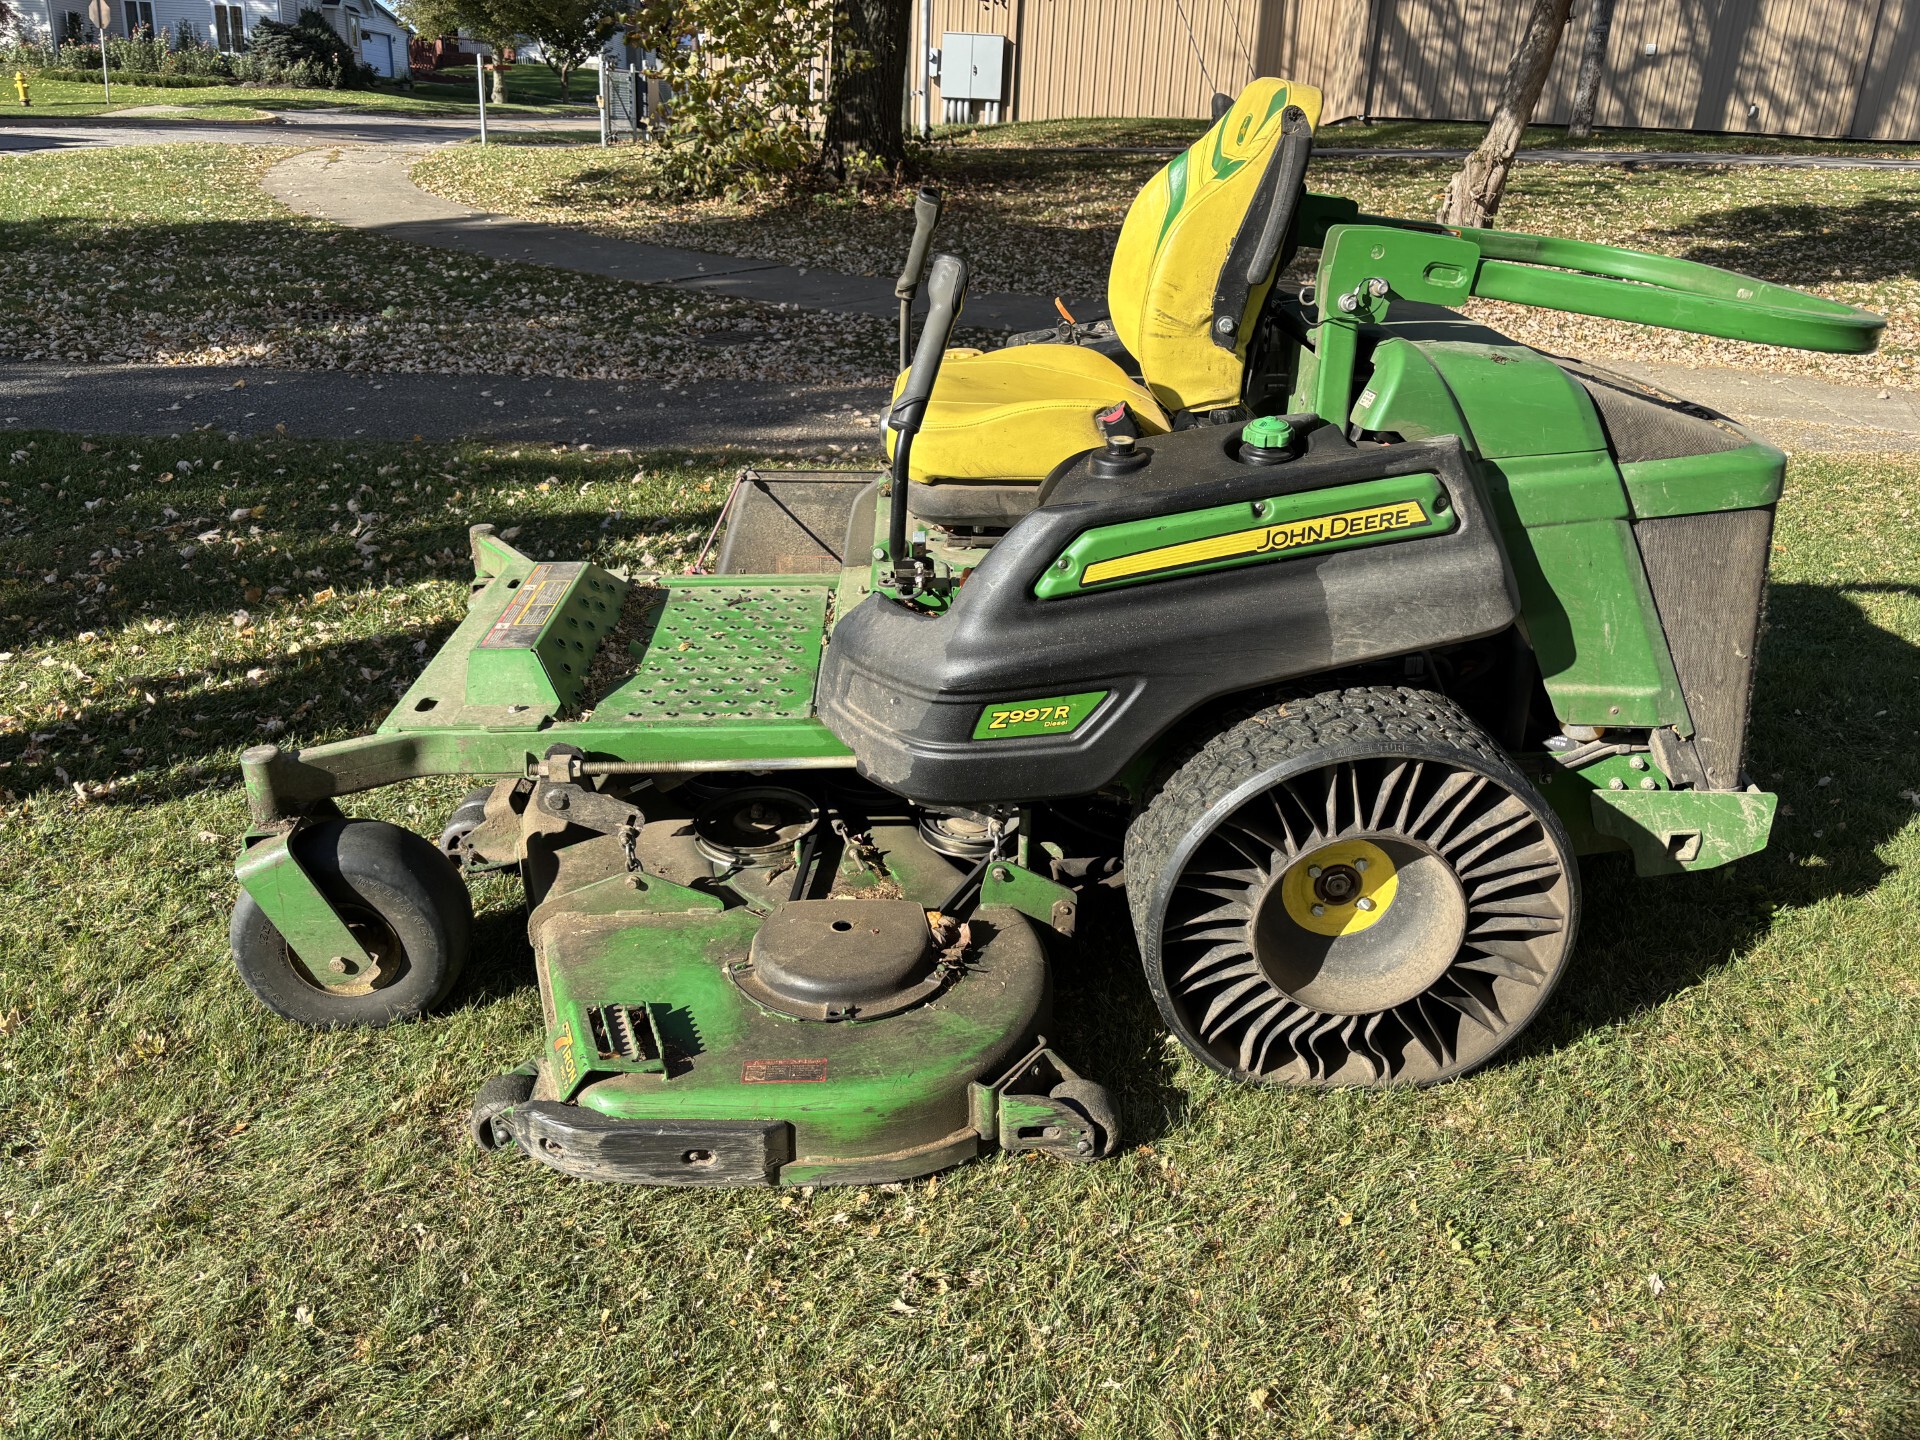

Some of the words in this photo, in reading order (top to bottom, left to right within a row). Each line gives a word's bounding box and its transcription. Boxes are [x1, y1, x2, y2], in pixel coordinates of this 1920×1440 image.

[1256, 523, 1324, 550] JOHN
[1330, 508, 1410, 537] DEERE
[988, 705, 1071, 730] Z997R
[1043, 719, 1068, 728] Diesel
